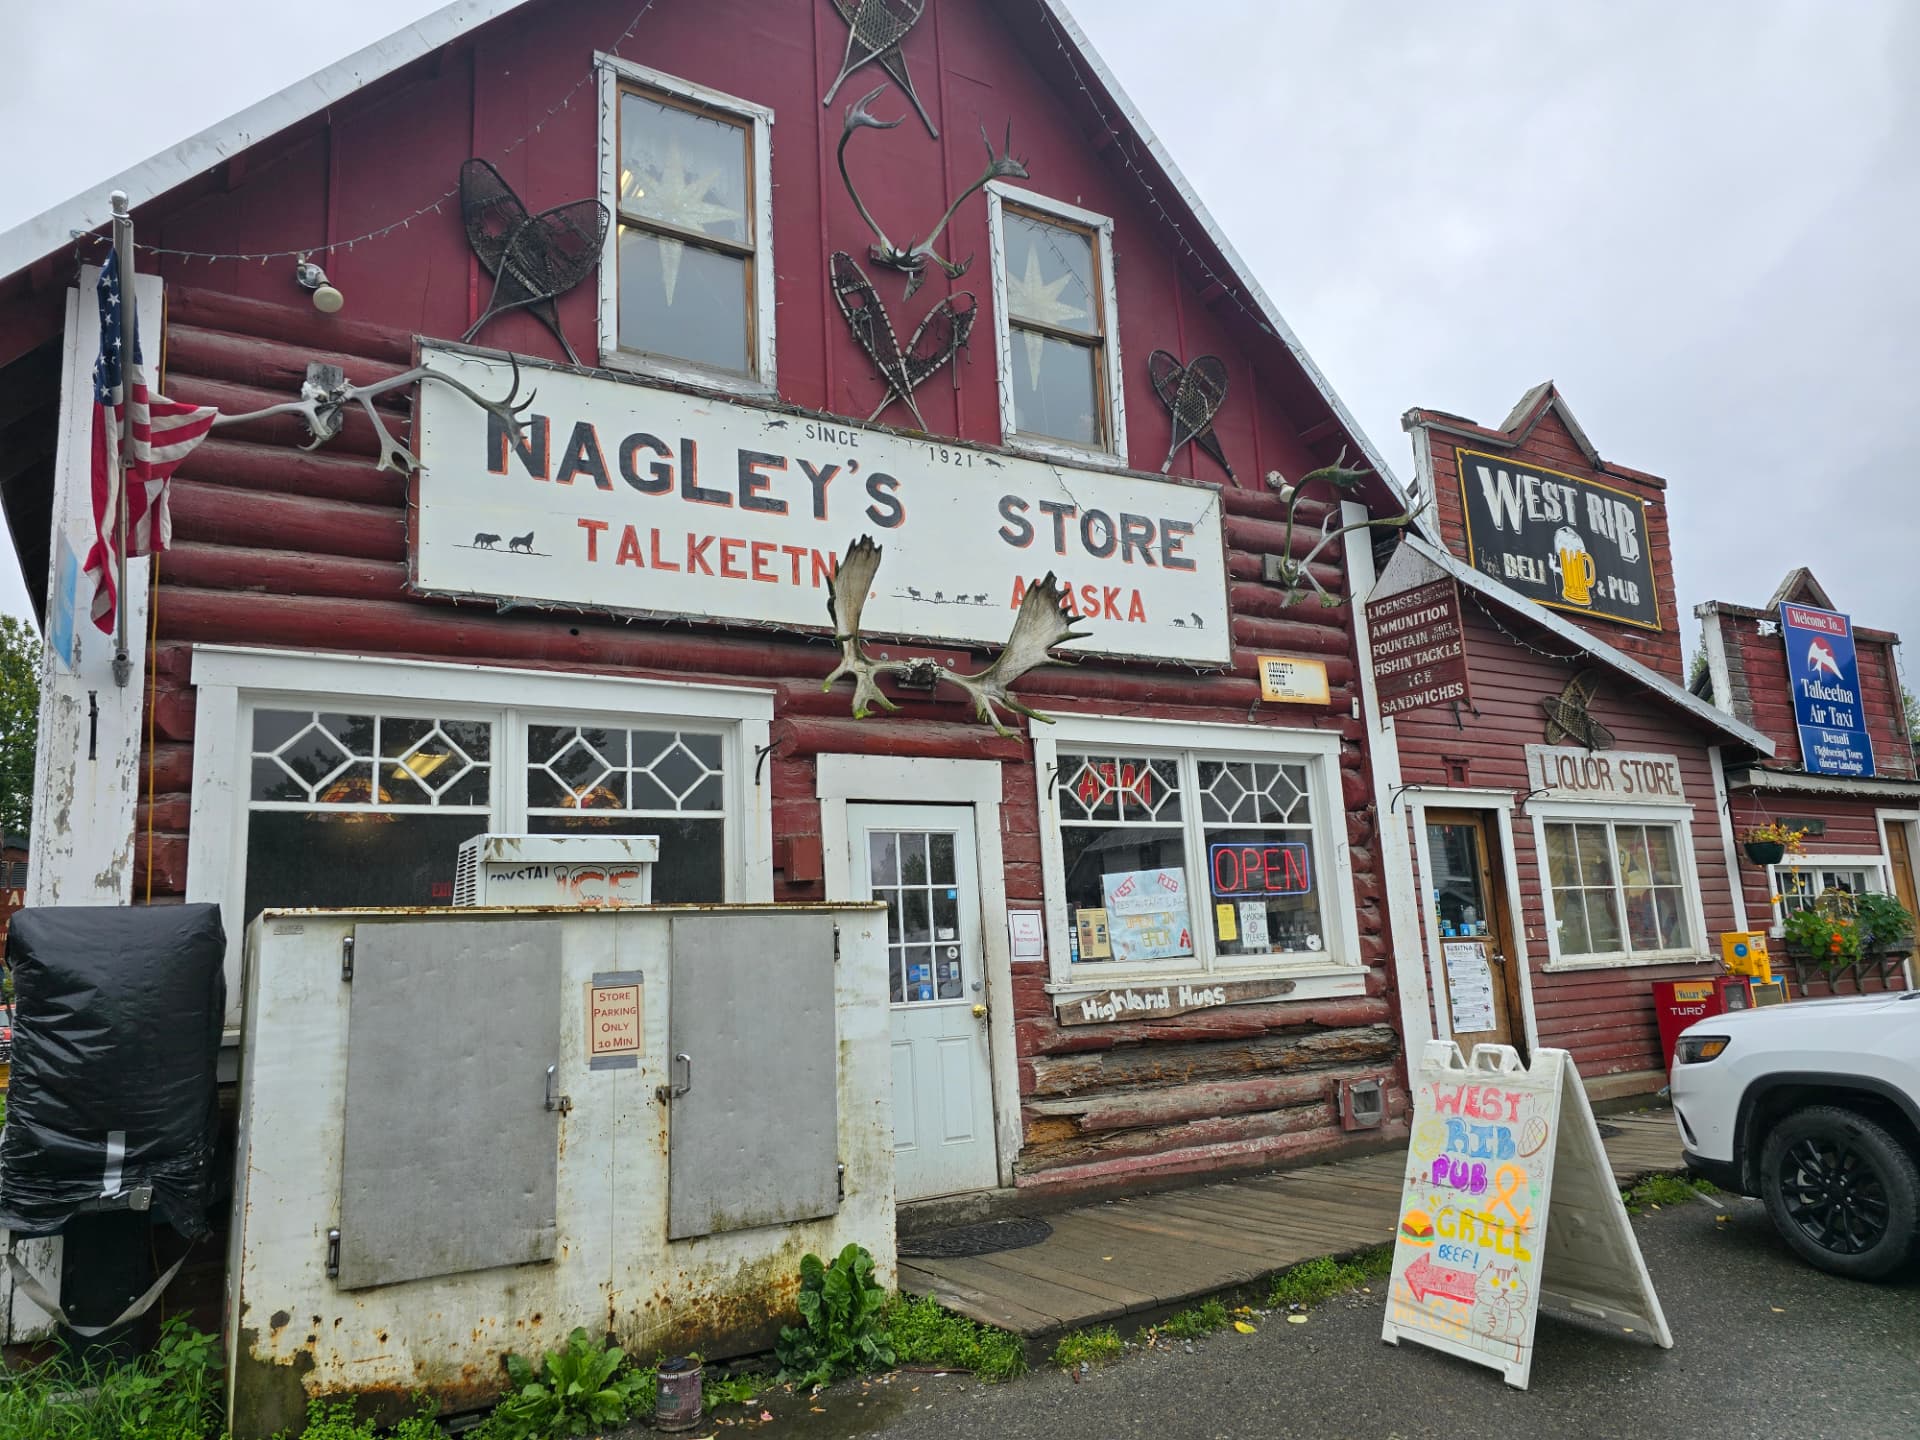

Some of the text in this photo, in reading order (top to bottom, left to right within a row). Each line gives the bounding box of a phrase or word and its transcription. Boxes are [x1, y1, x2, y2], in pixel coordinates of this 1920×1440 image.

[929, 446, 974, 468] 1921
[486, 403, 1197, 572] NAGLEY'S STORE
[1476, 465, 1578, 535] WEST
[1585, 491, 1641, 564] RIB
[1502, 552, 1548, 585] DELI
[1597, 580, 1607, 599] &
[1607, 575, 1641, 606] PUB
[1010, 575, 1148, 623] AASKA
[1368, 593, 1422, 619] LICENSES
[1372, 603, 1449, 639] AMMUNITION
[1791, 609, 1826, 629] Welcome
[1372, 632, 1428, 657] FOUNTAIN
[1374, 641, 1461, 677] FISHIN TACKLE
[1381, 682, 1464, 714] SANDWICHES
[1801, 678, 1854, 704] Talkeetna
[1810, 703, 1854, 728] Air Taxi
[1822, 731, 1850, 745] Denali
[1078, 762, 1152, 806] ATM
[1539, 753, 1679, 796] LIQUOR STORE
[1157, 872, 1179, 893] RIB
[1214, 847, 1307, 891] OPEN
[1080, 986, 1170, 1021] Highland
[599, 1040, 611, 1049] 10
[1431, 1082, 1521, 1122] WEST
[1445, 1117, 1516, 1160] RIB
[1431, 1154, 1488, 1196] PUB
[1437, 1205, 1532, 1263] GRILL
[1438, 1243, 1479, 1269] BEEF!
